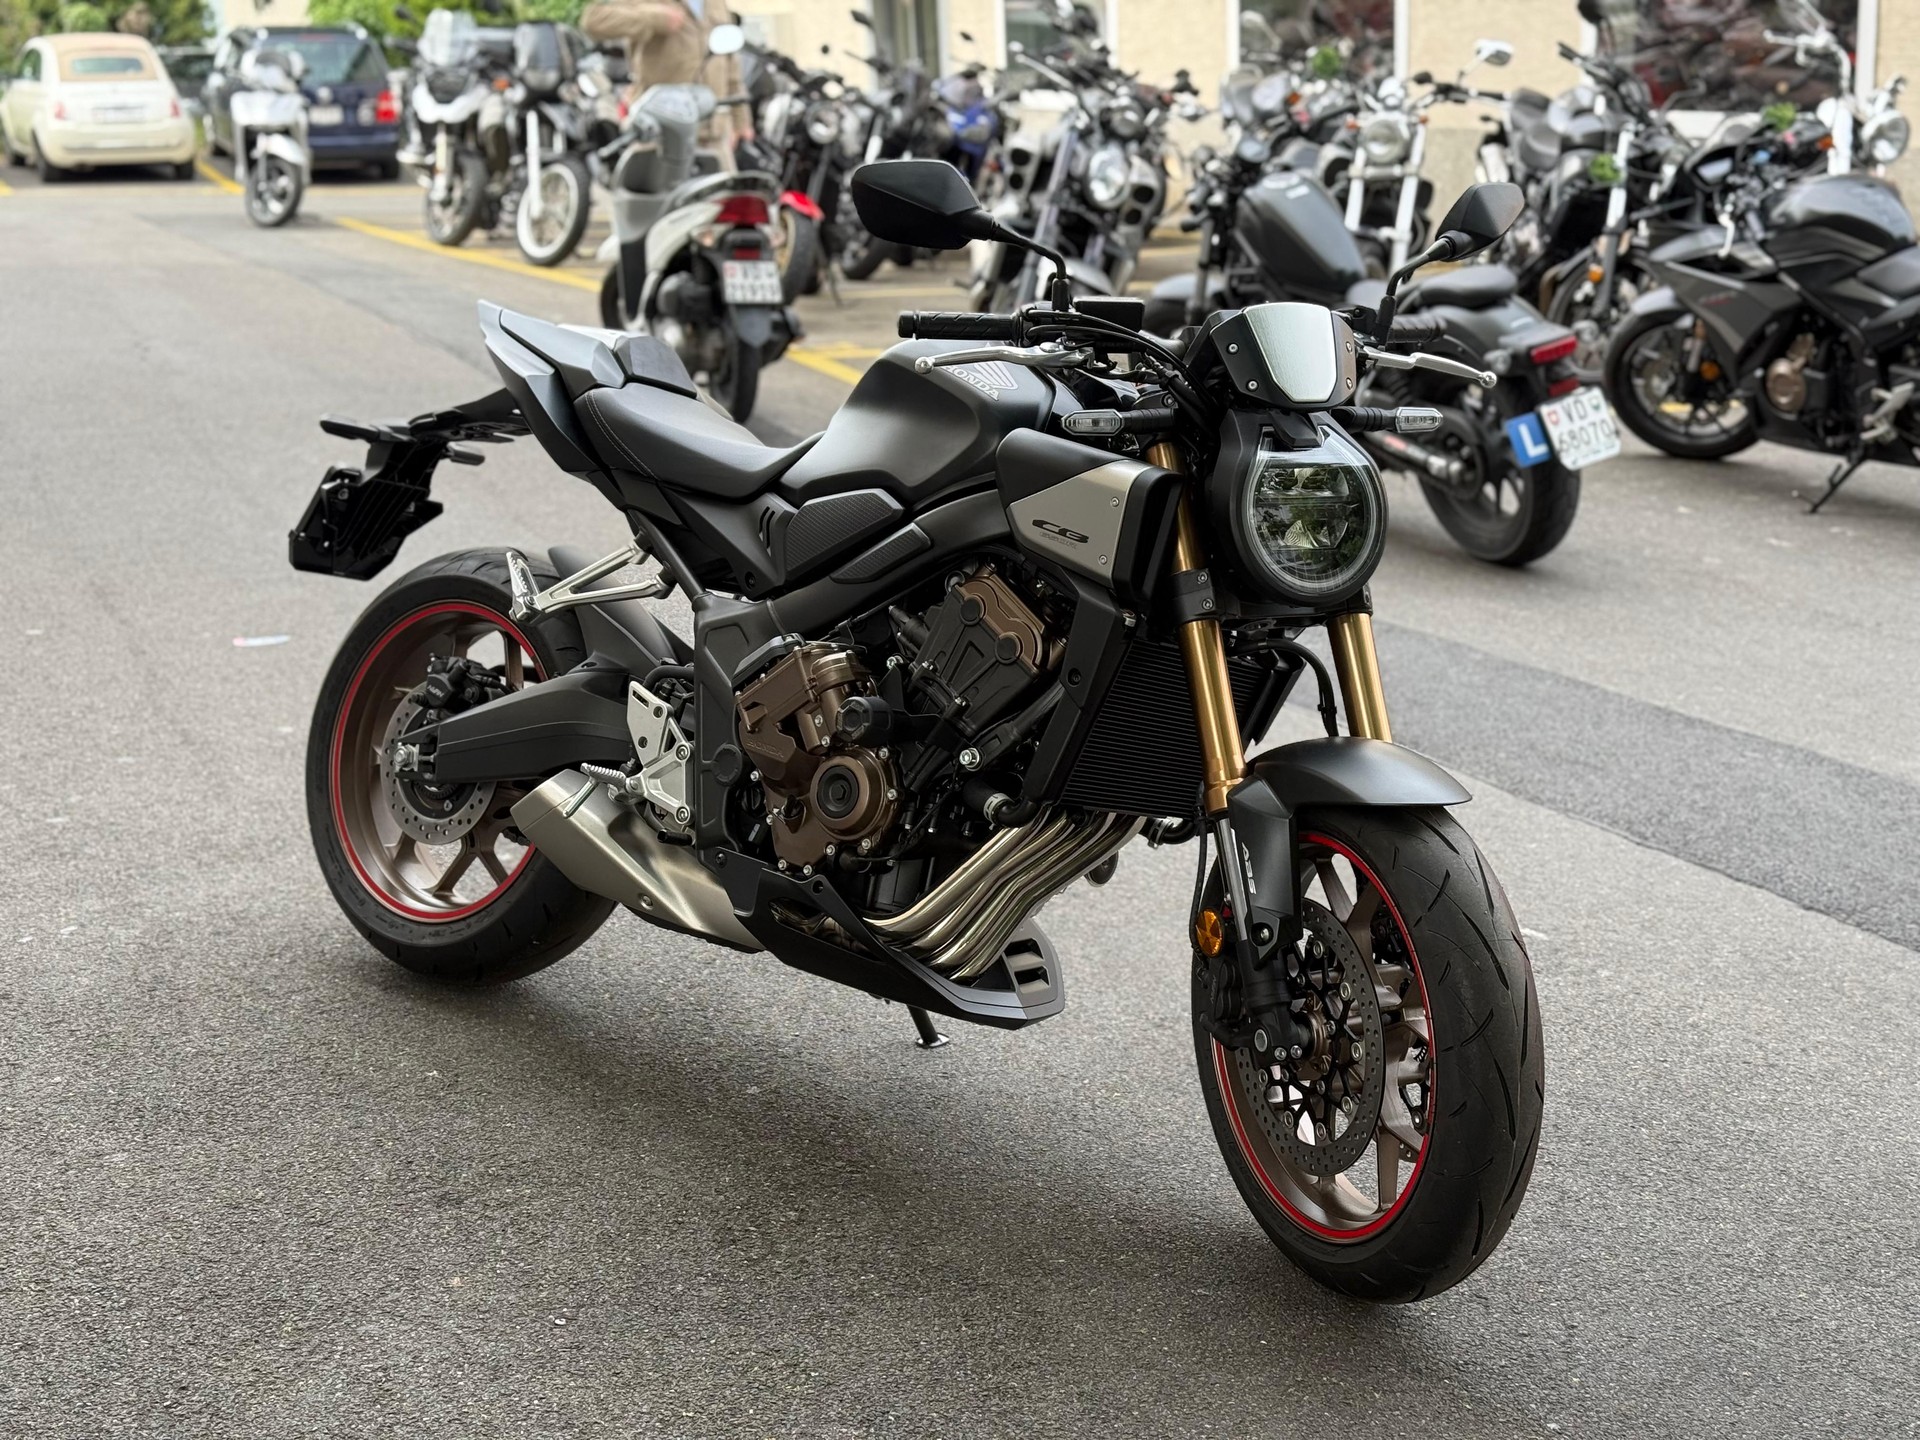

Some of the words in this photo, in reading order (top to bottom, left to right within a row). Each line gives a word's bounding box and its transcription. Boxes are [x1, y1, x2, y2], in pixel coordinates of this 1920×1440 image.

[1561, 399, 1588, 421] VD
[1518, 422, 1549, 459] L
[1557, 419, 1613, 453] 68070
[1032, 519, 1089, 543] CB
[1241, 841, 1257, 894] ABS
